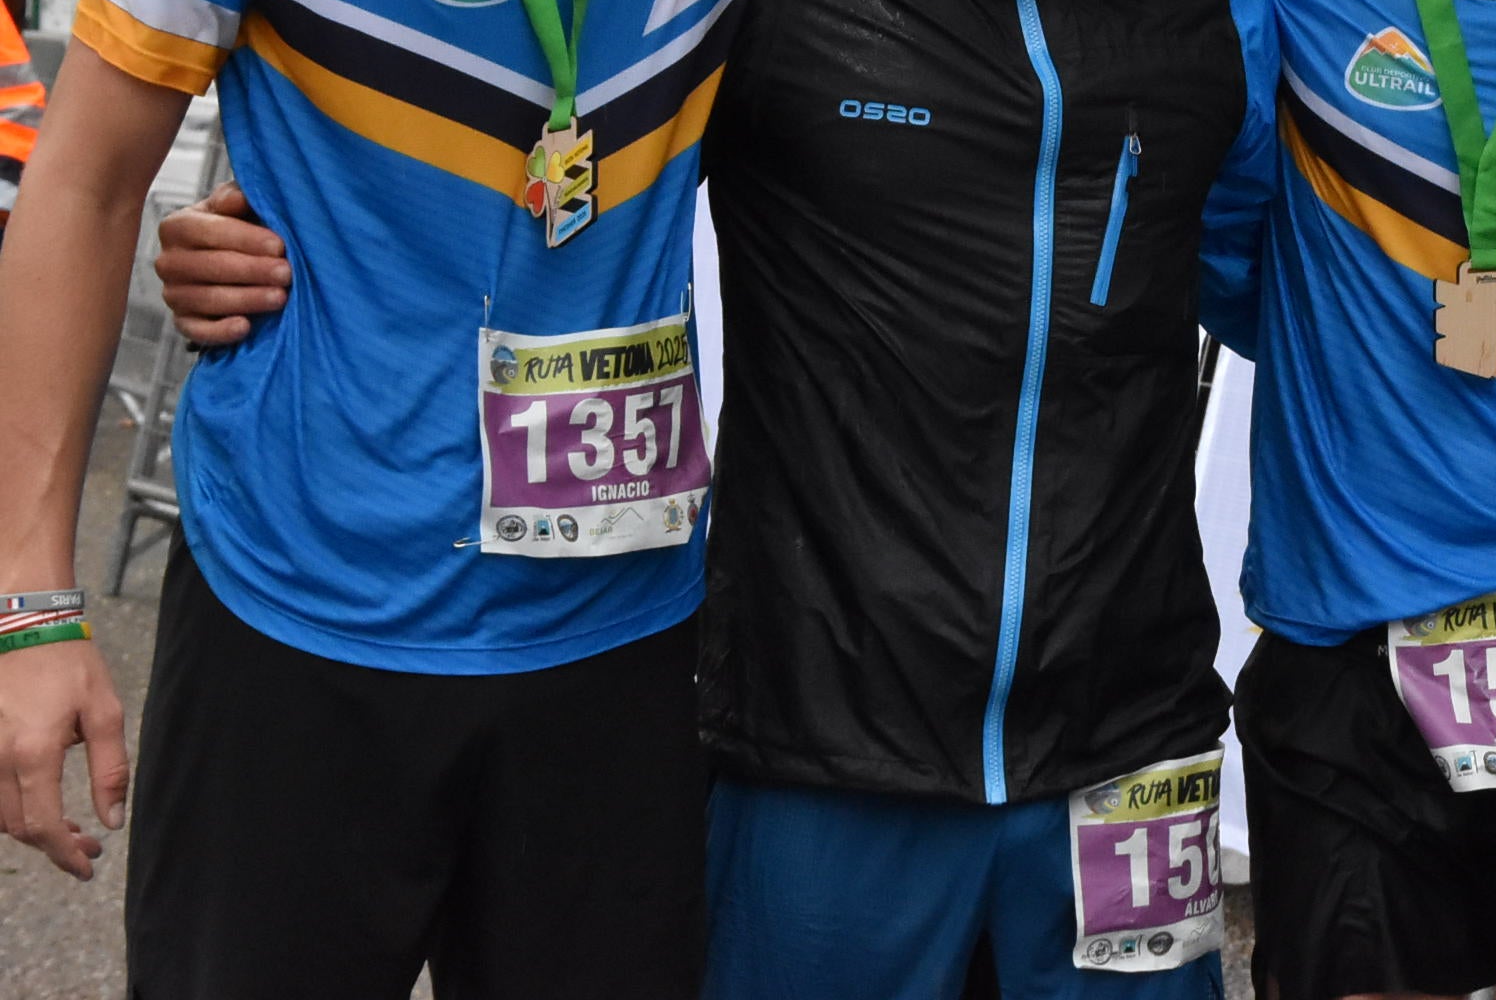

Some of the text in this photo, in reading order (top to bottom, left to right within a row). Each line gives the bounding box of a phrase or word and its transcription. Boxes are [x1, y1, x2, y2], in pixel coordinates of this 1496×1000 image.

[1354, 71, 1436, 97] ULTRAIL
[524, 351, 574, 383] RUTA
[656, 332, 689, 372] 2025
[510, 384, 684, 484] 1357
[592, 480, 650, 502] IGNACIO
[1441, 601, 1489, 632] RUTA
[1127, 778, 1172, 809] RUTA
